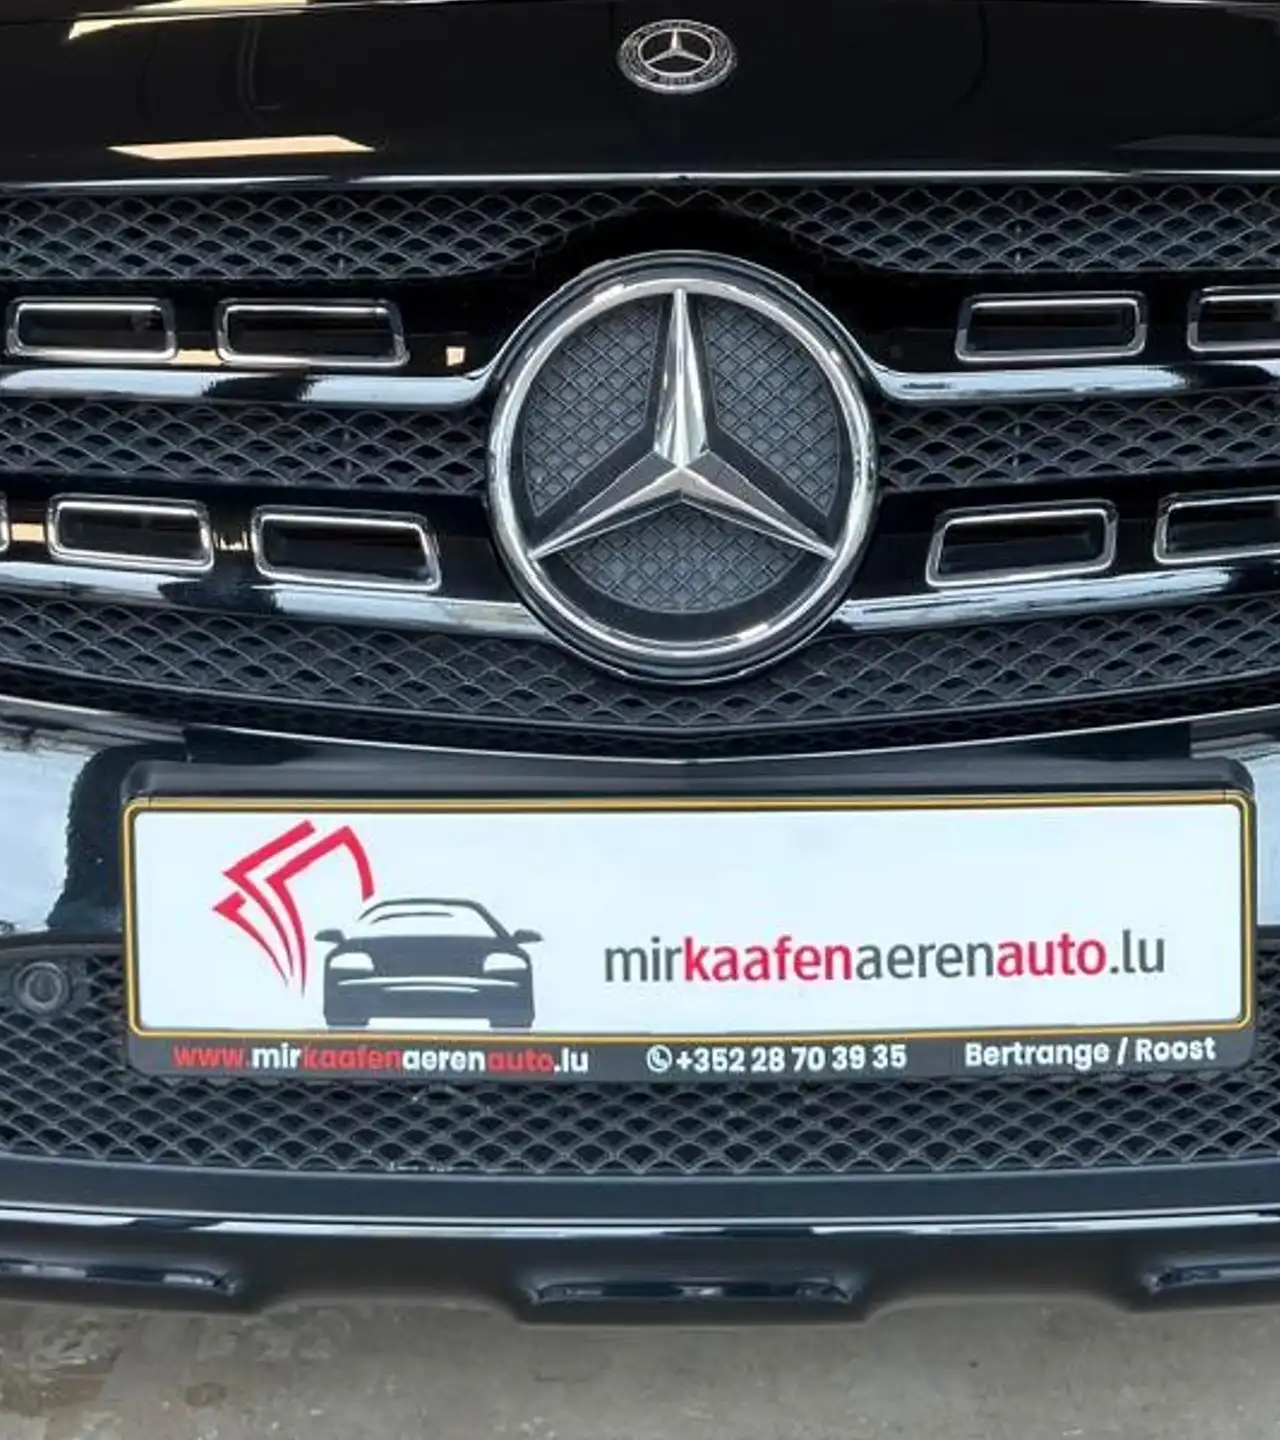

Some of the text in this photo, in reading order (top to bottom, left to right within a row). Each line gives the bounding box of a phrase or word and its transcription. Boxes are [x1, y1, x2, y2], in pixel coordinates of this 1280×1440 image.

[604, 929, 1165, 983] mirkaafenaerenauto.lu
[173, 1041, 589, 1072] www.mirkaafenaerenauto.lu
[675, 1043, 908, 1072] +352 28 70 39 35
[965, 1041, 1110, 1071] Bertrange
[1135, 1036, 1217, 1063] Roost
